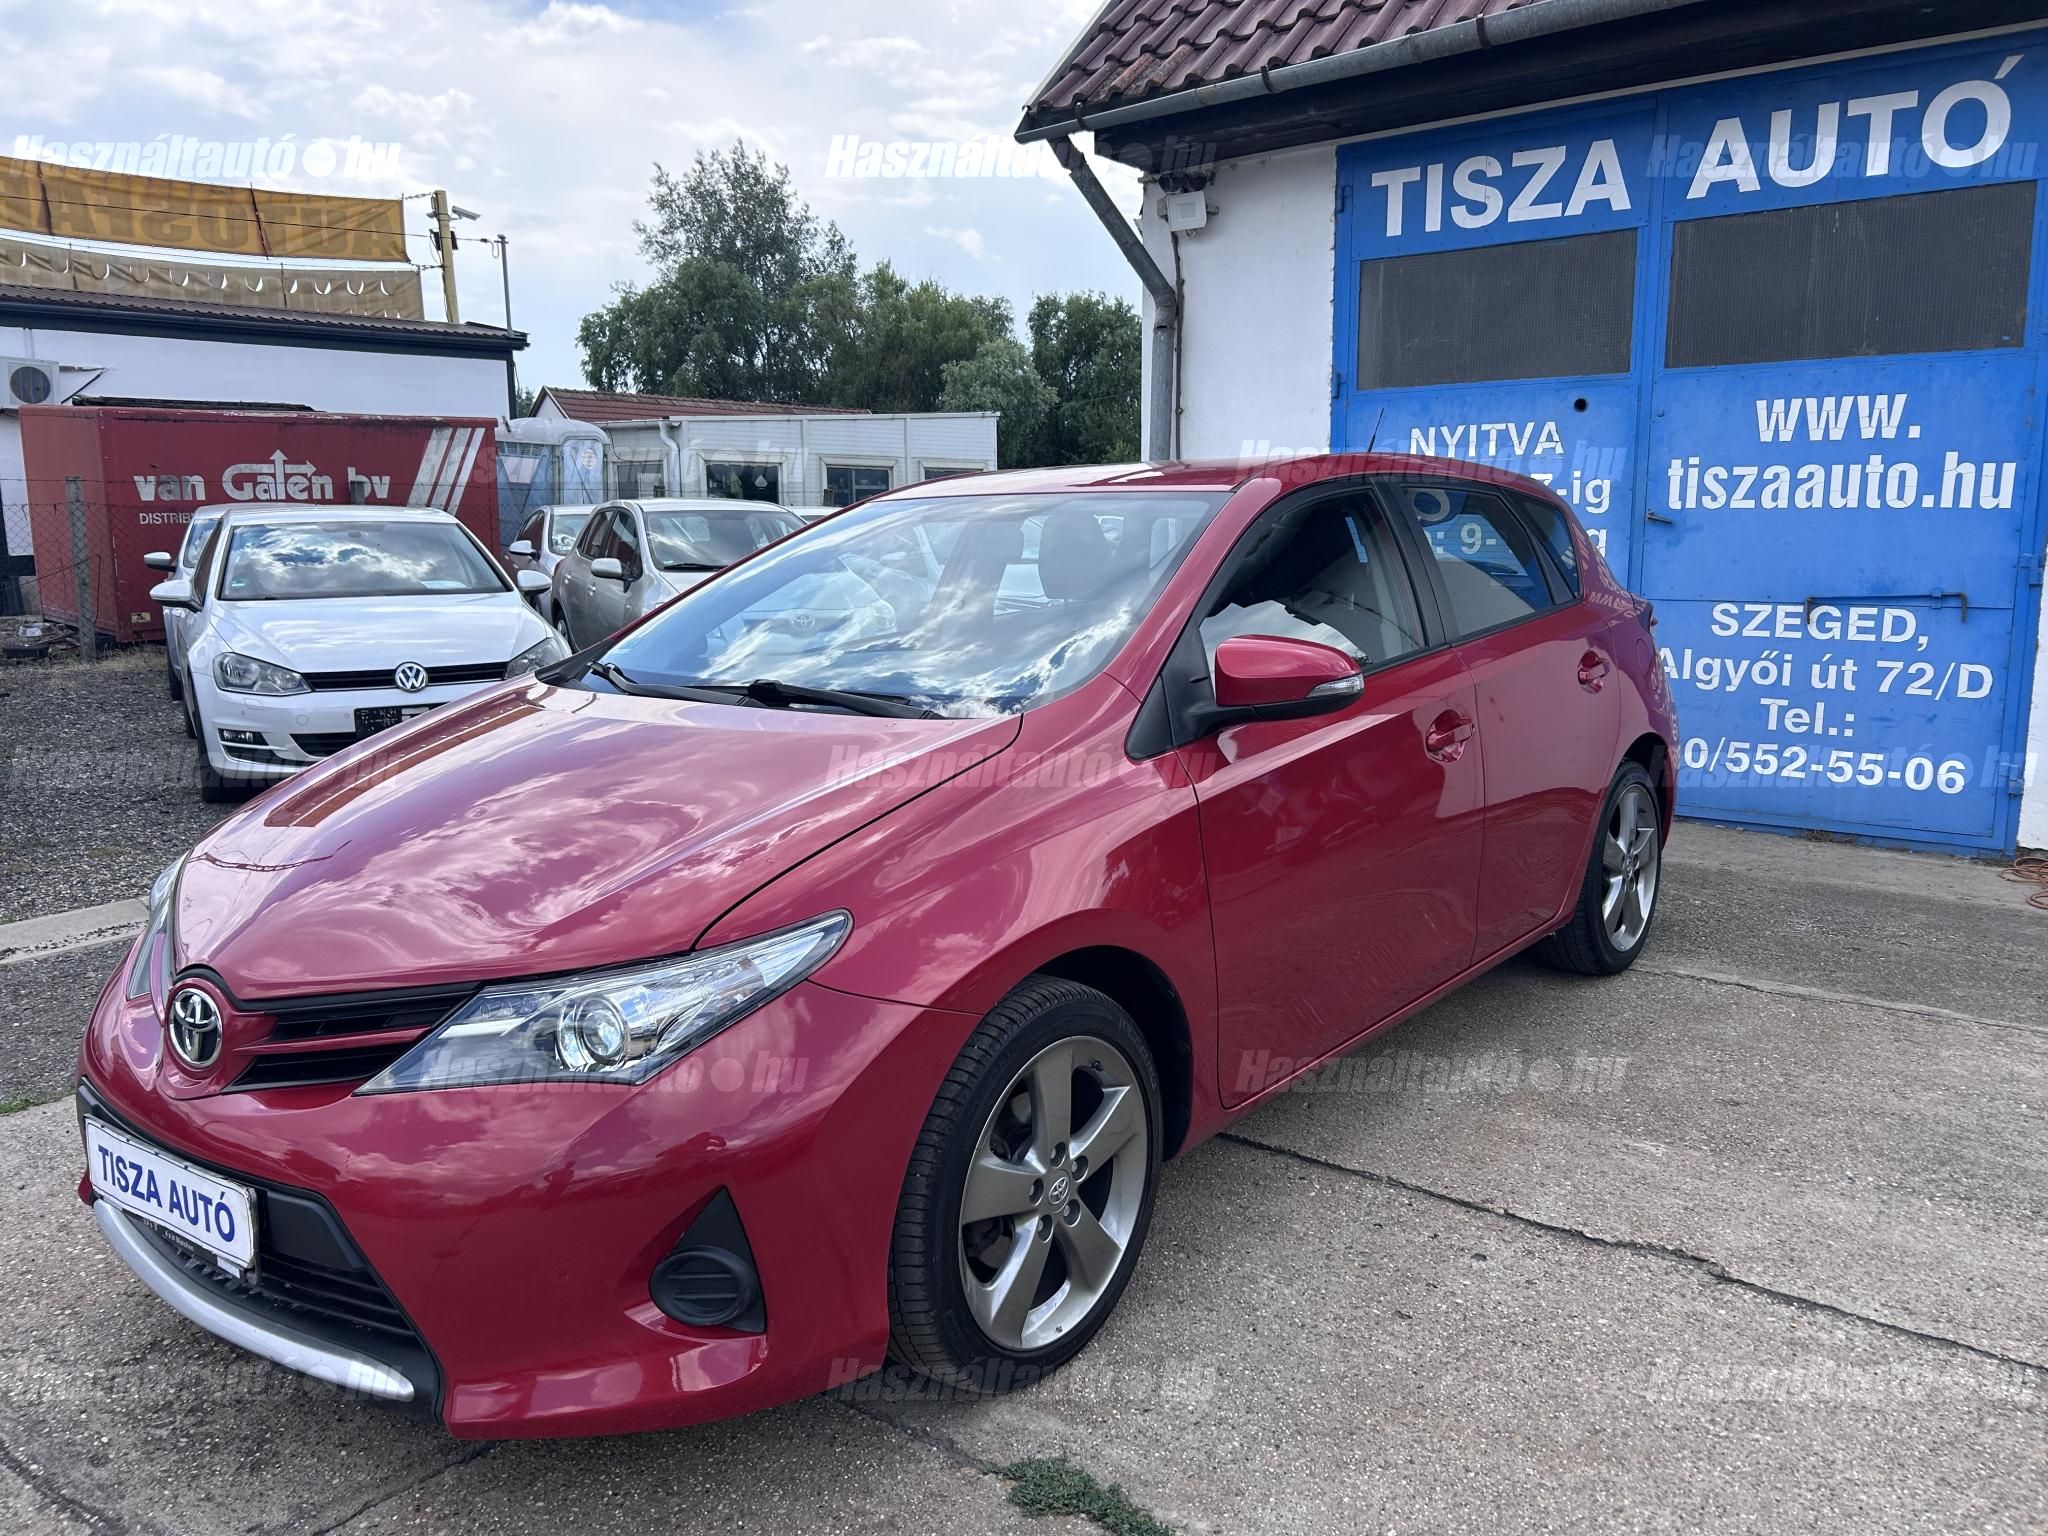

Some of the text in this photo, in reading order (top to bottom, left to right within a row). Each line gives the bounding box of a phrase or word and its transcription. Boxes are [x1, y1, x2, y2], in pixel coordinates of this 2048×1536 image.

[1372, 54, 2025, 237] TISZA AUTÓ
[1410, 421, 1565, 458] NYITVA
[1756, 393, 1921, 442] www.
[133, 475, 205, 501] van
[1668, 451, 2016, 509] tiszaauto.hu
[139, 512, 193, 525] DISTRIB
[1711, 603, 1929, 651] SZEGED,
[1659, 647, 1994, 700] Algyői út 72/D
[1760, 697, 1855, 737] Tel.:
[98, 1144, 163, 1208] TISZA
[169, 1179, 236, 1243] AUTÓ
